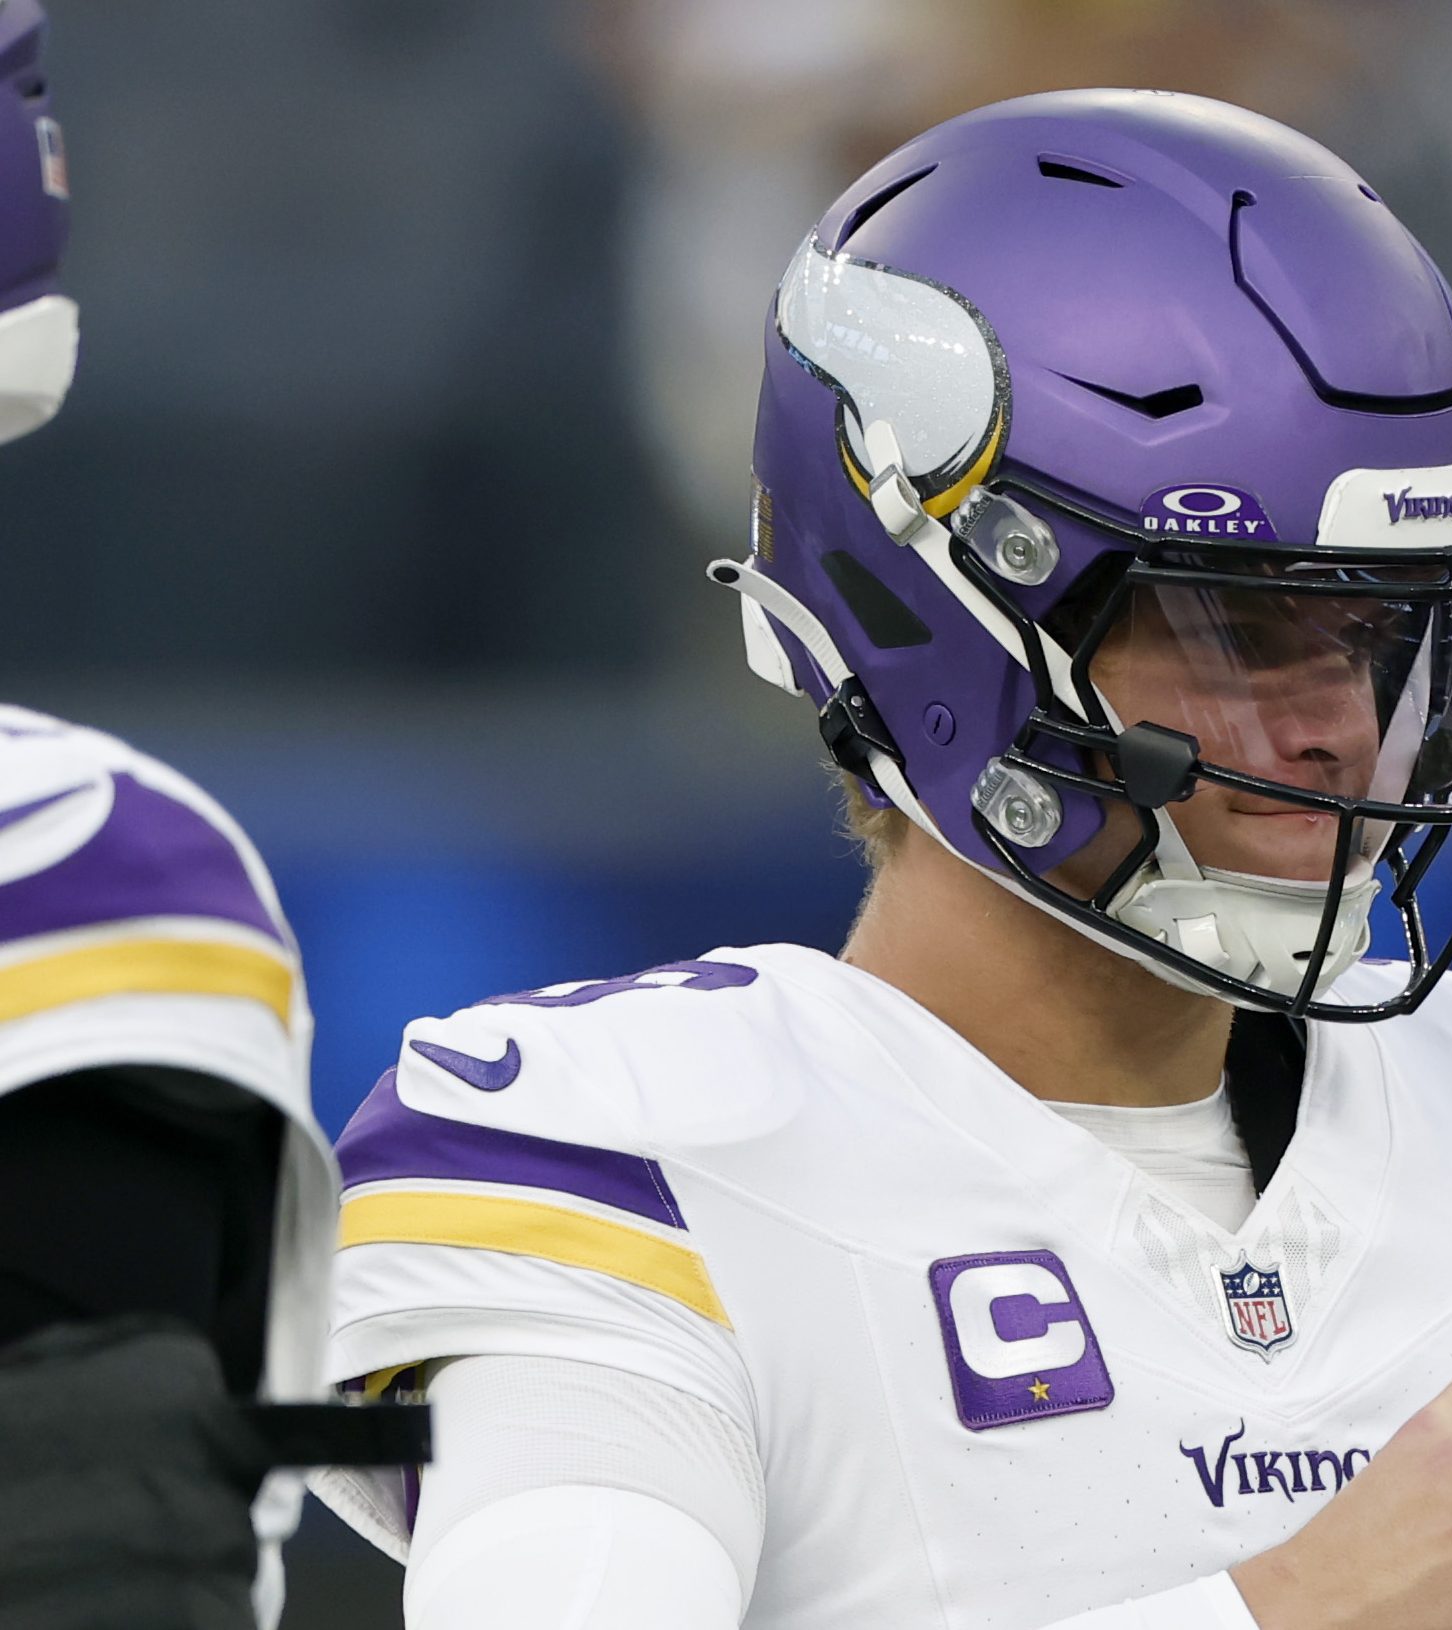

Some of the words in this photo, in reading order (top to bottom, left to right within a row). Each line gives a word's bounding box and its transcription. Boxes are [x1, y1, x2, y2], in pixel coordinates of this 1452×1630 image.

[1143, 516, 1260, 534] OAKLEY
[950, 1263, 1086, 1379] C
[1233, 1300, 1287, 1340] NFL
